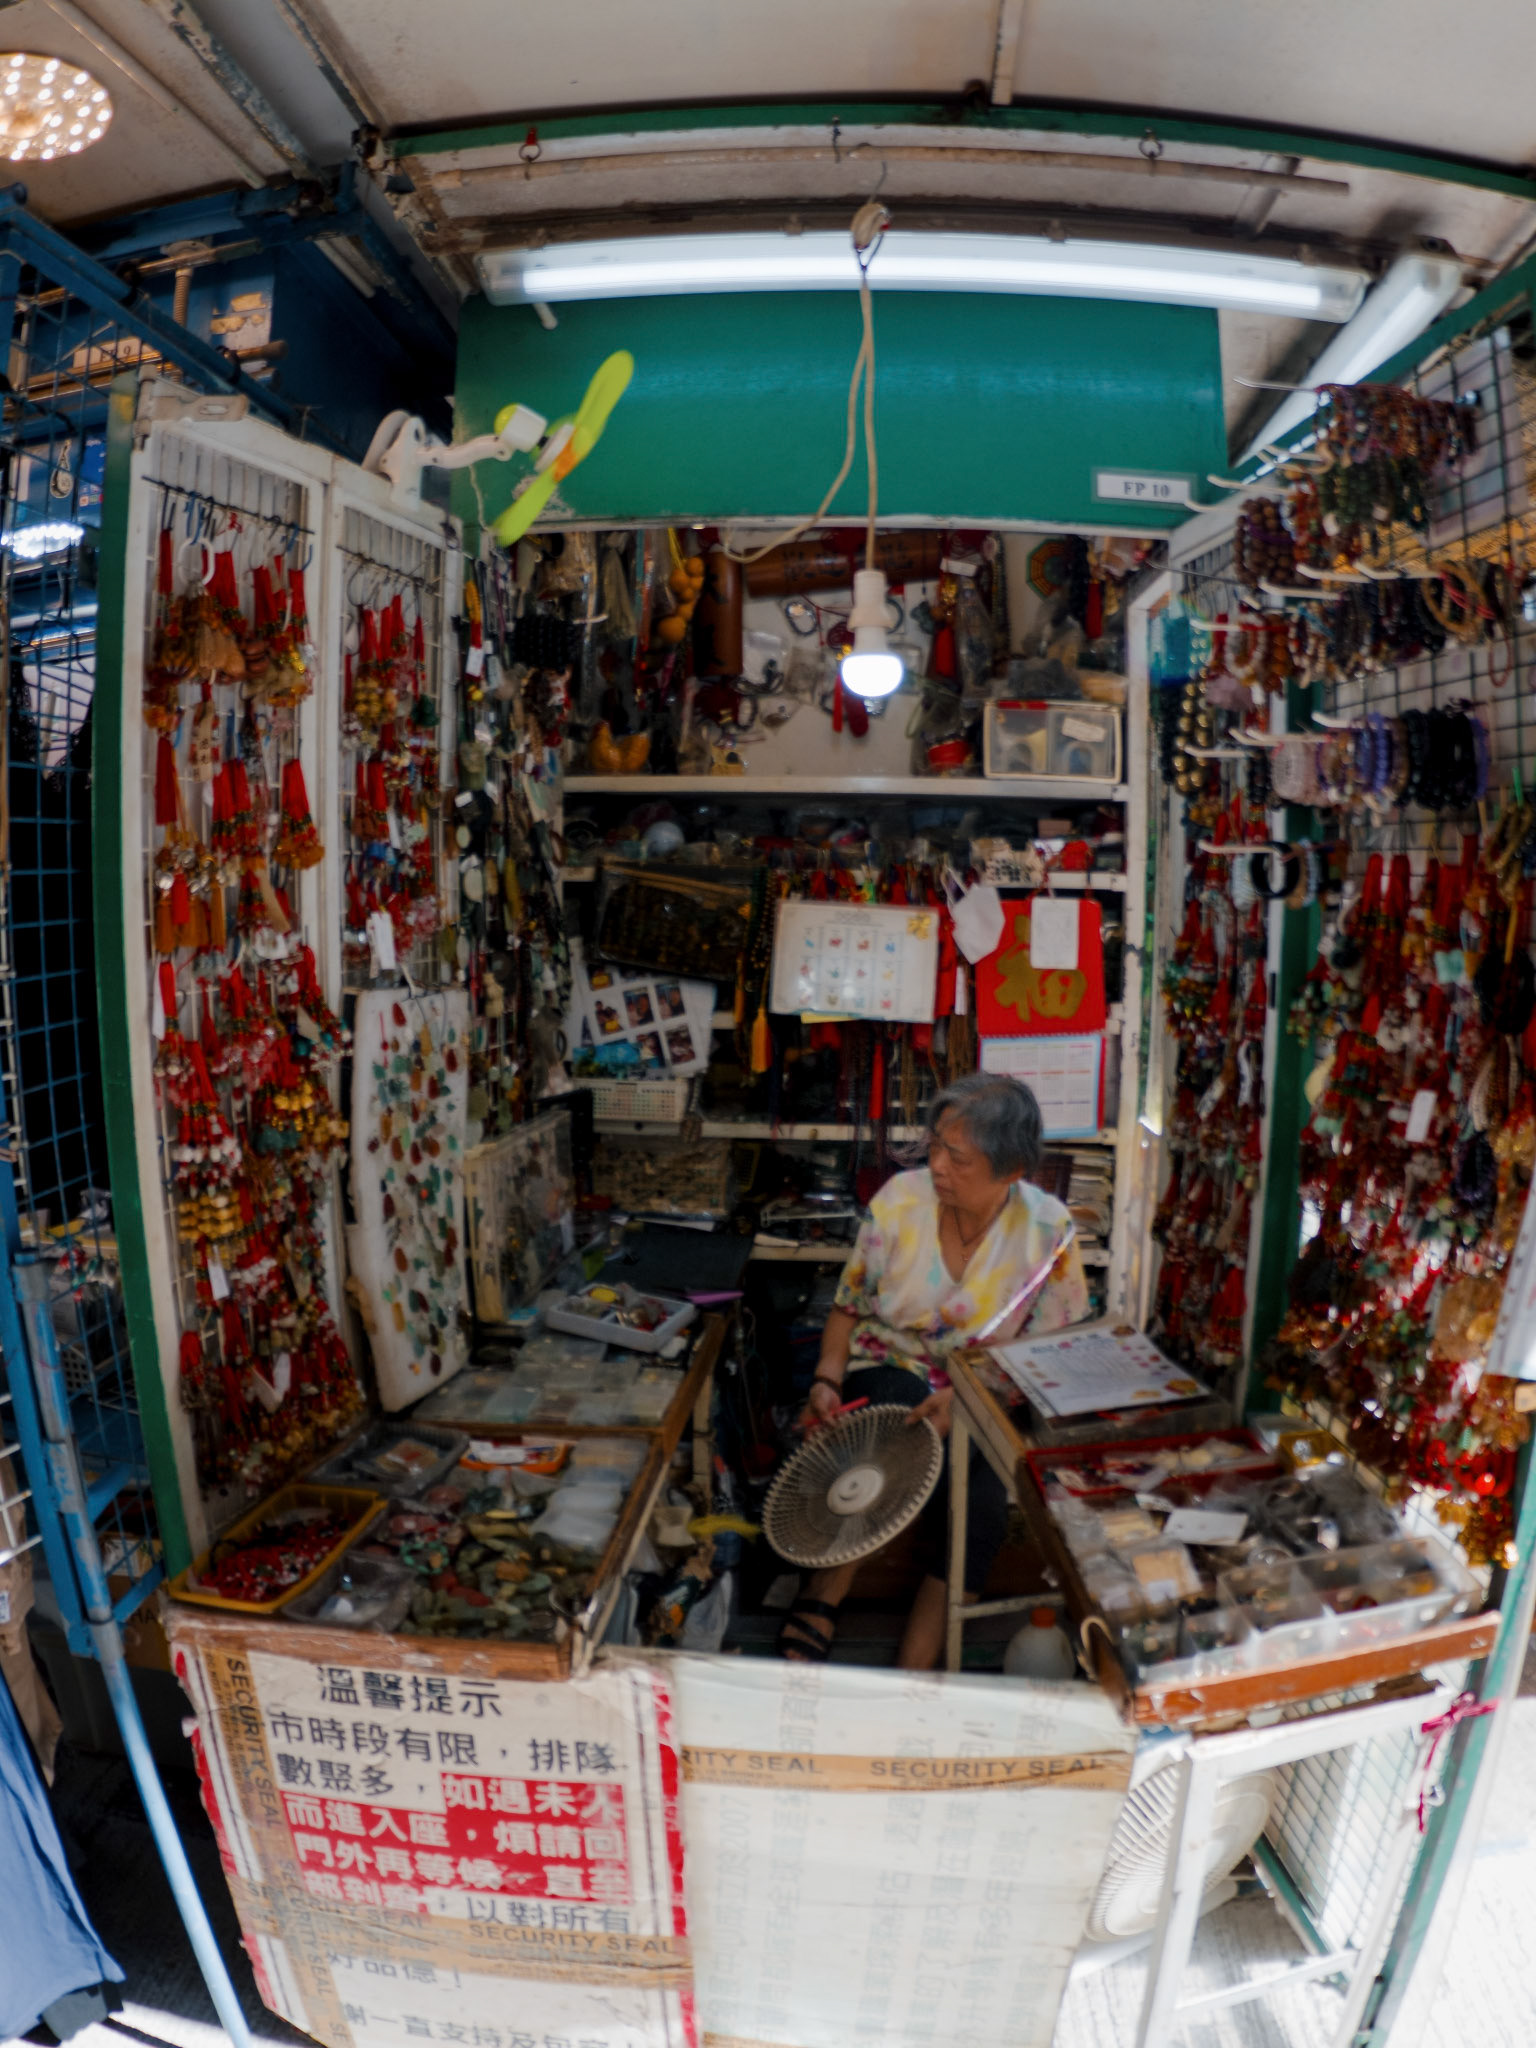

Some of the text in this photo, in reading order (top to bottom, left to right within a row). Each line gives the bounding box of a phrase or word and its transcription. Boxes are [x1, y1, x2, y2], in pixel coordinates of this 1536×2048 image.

[1123, 481, 1171, 498] FP 10
[318, 1664, 502, 1718] 溫馨提示
[227, 1658, 267, 1776] SECURITY
[255, 1776, 283, 1828] SEAL
[748, 1756, 823, 1774] SEAL
[870, 1760, 1018, 1778] SECURITY
[469, 1924, 676, 1955] SECURITY SEAL
